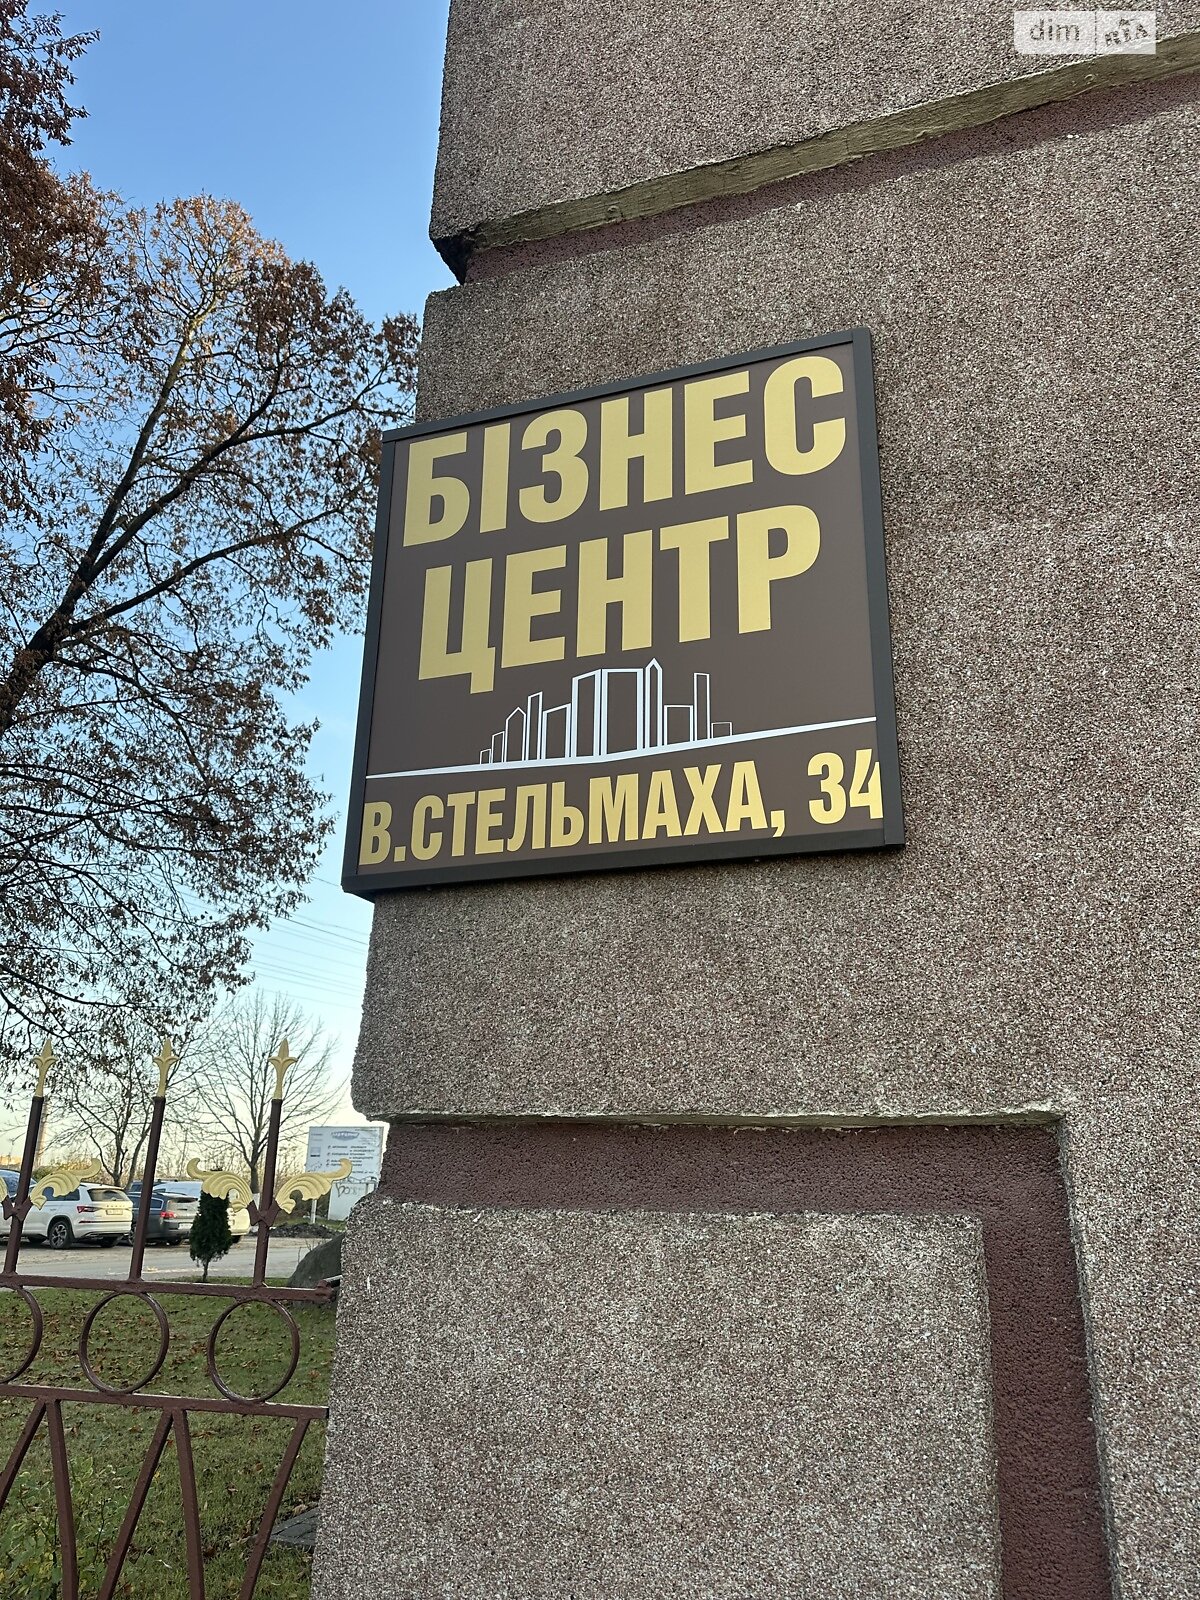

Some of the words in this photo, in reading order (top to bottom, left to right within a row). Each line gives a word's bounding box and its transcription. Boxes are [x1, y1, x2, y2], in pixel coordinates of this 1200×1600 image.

[403, 356, 847, 548] БІЗНЕС
[418, 505, 821, 694] ЦЕНТР
[358, 760, 786, 866] В.СТЕЛЬМАХА,
[807, 748, 884, 825] 34
